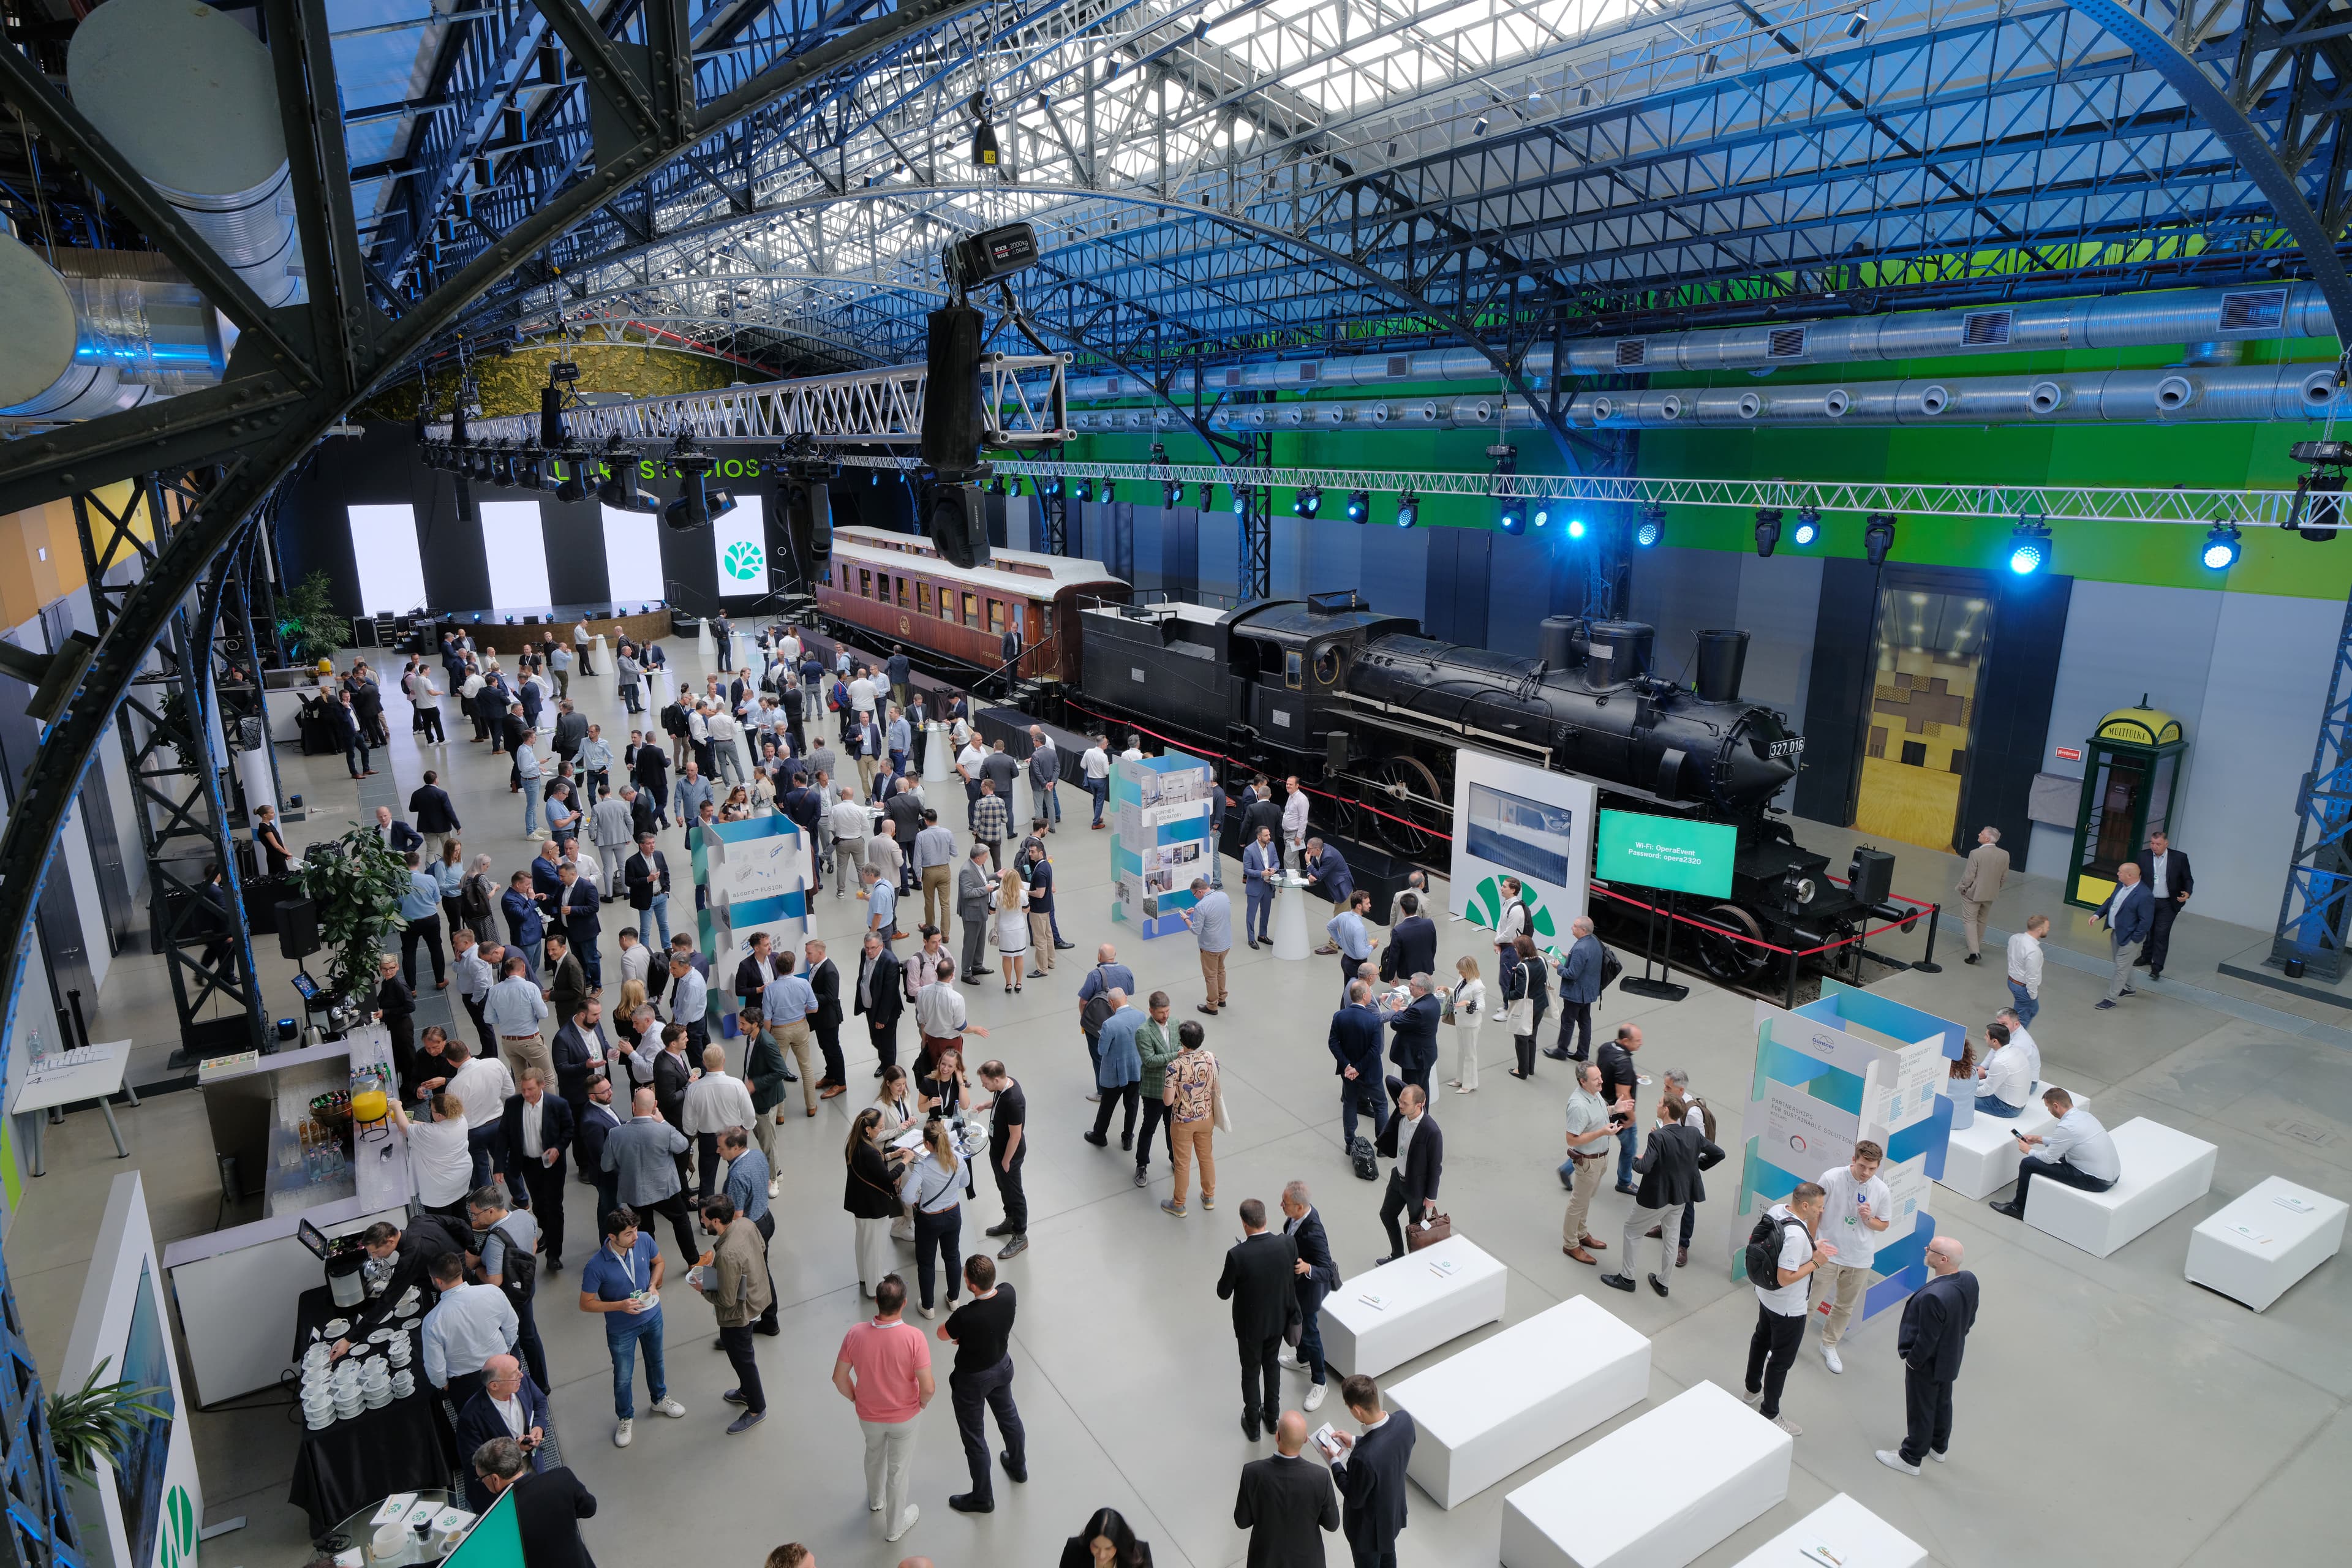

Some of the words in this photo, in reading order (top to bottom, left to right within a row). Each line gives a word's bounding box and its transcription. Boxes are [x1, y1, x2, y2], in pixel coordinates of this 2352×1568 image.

[641, 459, 760, 480] STIOS
[1771, 739, 1804, 756] 327.016
[1628, 848, 1662, 859] Password:
[1664, 855, 1702, 865] opera2320
[1635, 842, 1654, 850] Wi-Fi:
[1656, 845, 1695, 856] OperaEvent
[761, 884, 783, 892] FUSION
[1770, 1111, 1788, 1122] WIELAND
[1772, 1097, 1813, 1120] PARTNERSHIPS
[1783, 1110, 1822, 1131] SUSTAINABLE
[1823, 1128, 1856, 1147] SOLUTIONS
